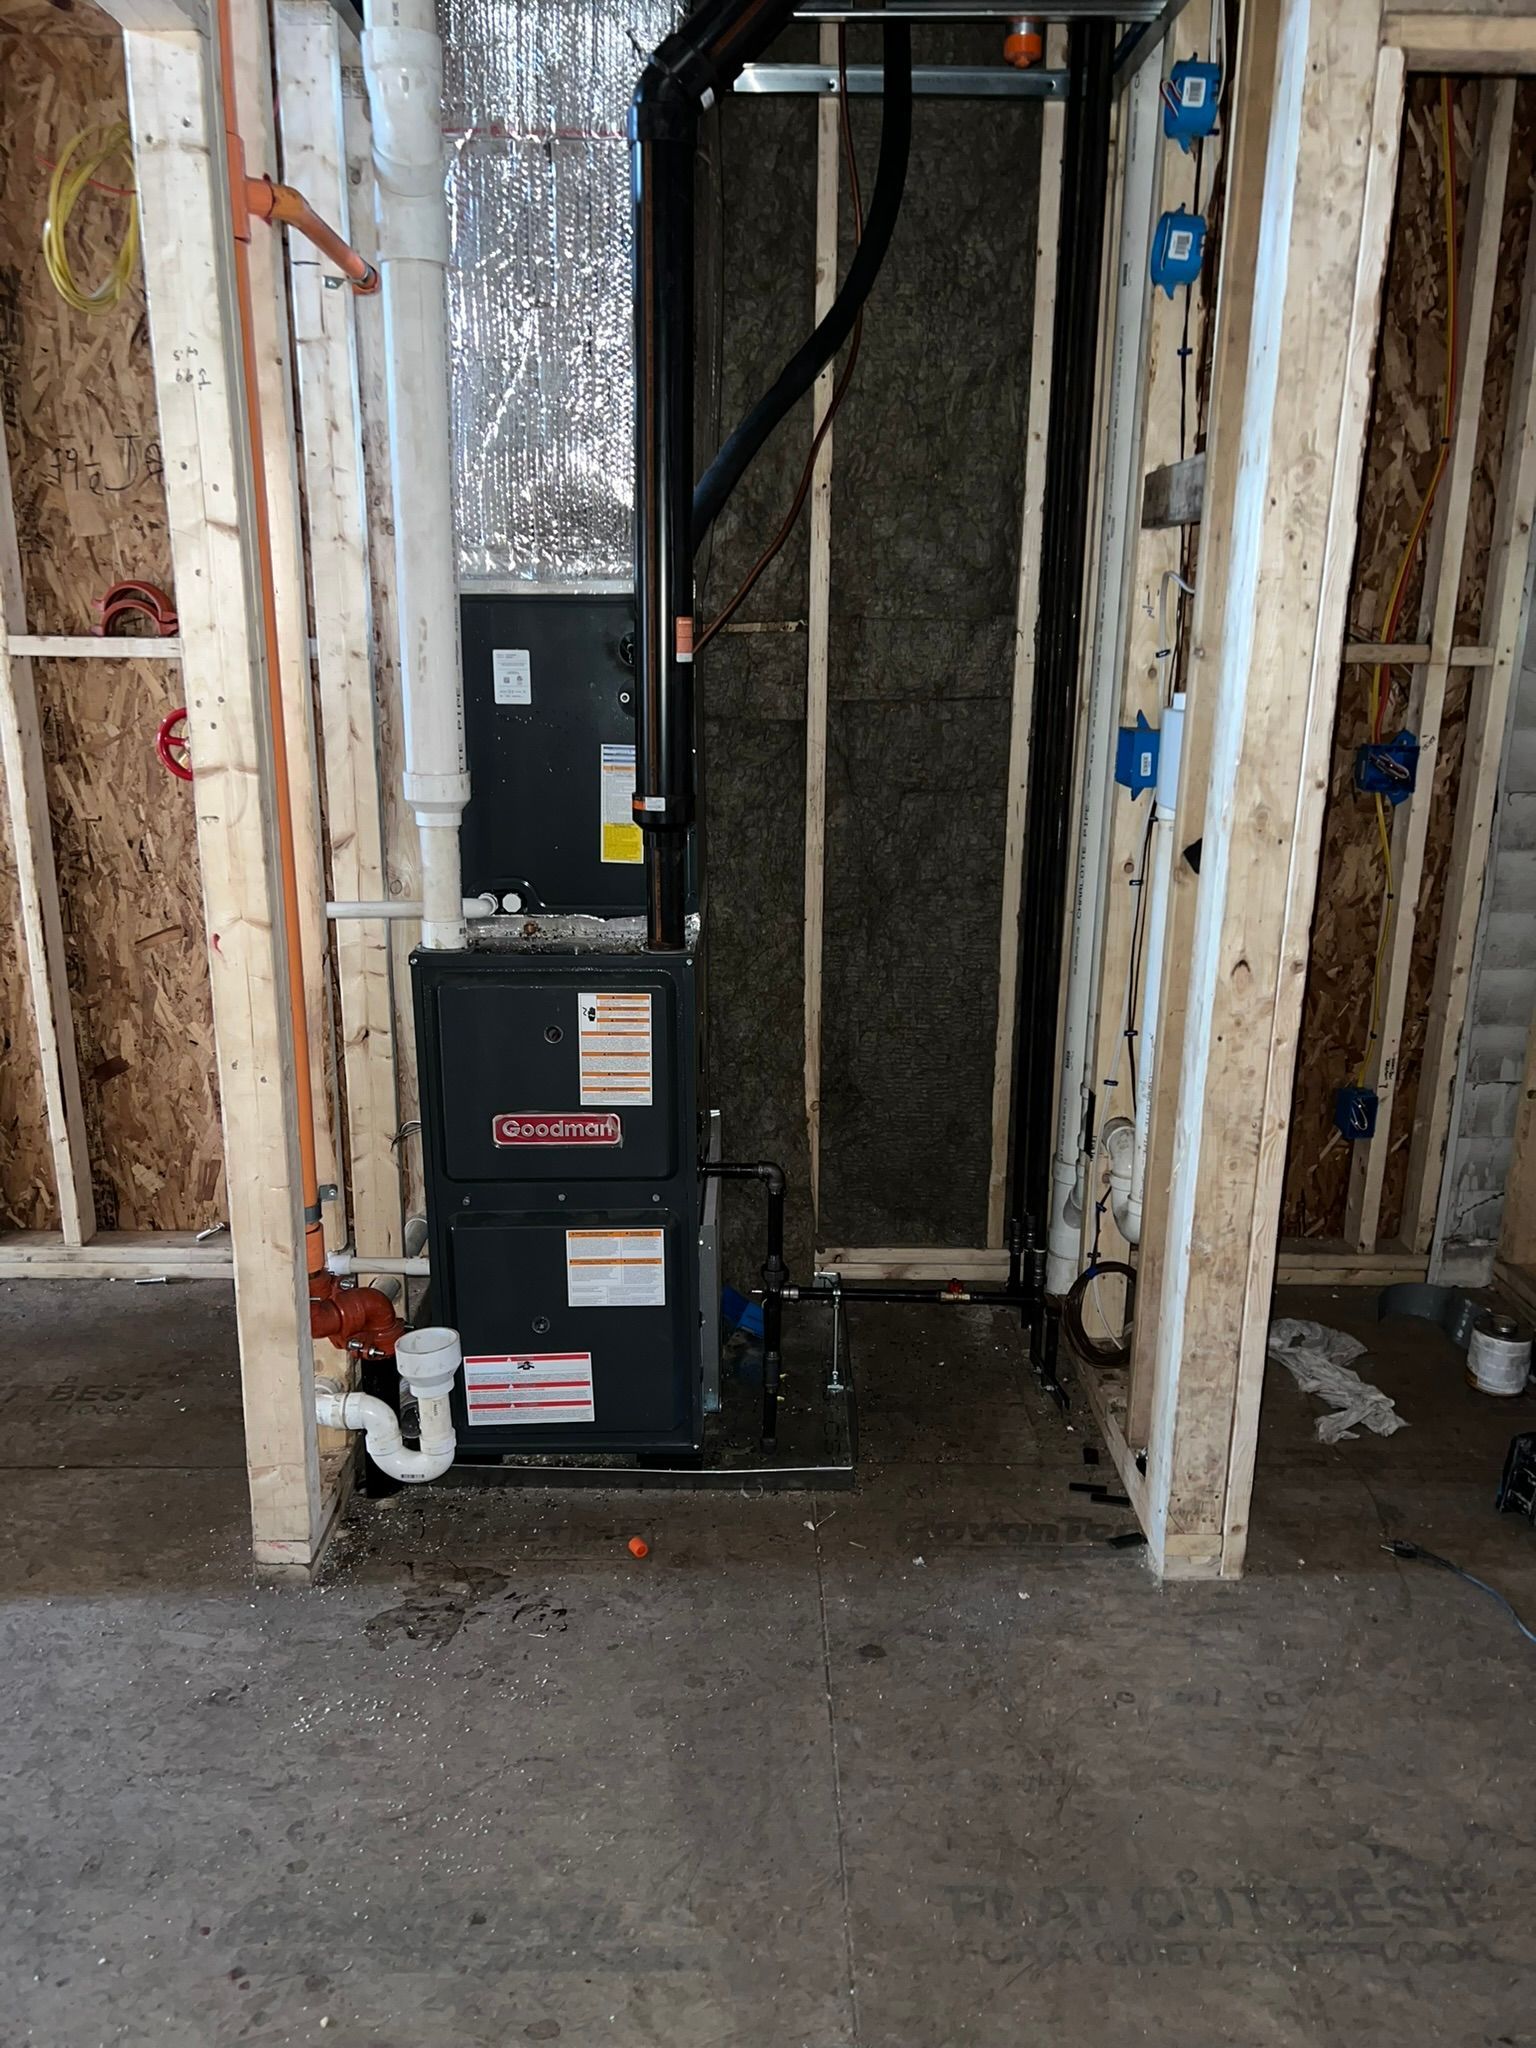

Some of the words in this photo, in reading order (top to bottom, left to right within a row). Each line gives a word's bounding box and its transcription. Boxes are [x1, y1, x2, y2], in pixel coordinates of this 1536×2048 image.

[1081, 803, 1090, 838] PIPE
[1075, 847, 1088, 920] CHARLOTTE
[502, 1119, 613, 1138] Goodman
[45, 1384, 153, 1402] BEST
[1288, 1882, 1474, 1931] BEST
